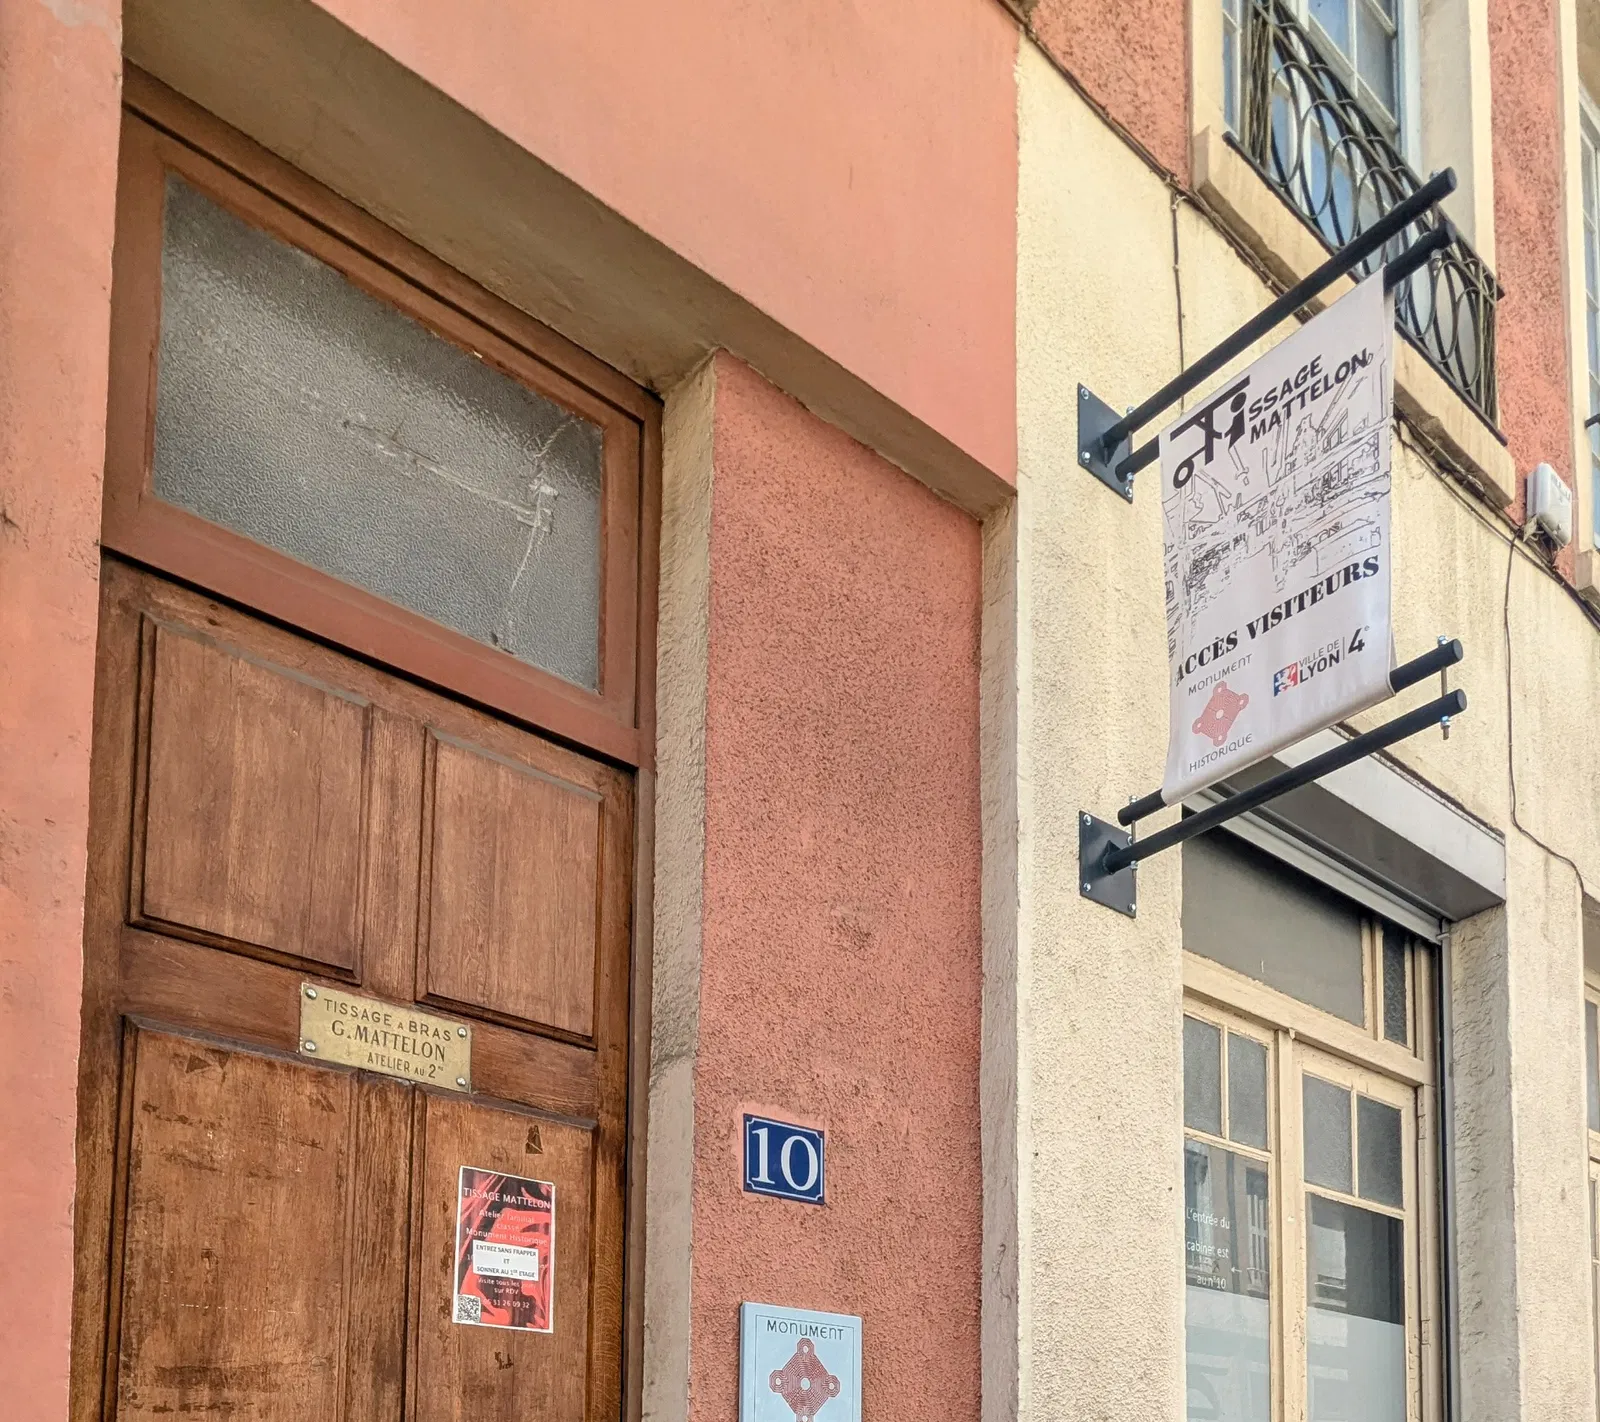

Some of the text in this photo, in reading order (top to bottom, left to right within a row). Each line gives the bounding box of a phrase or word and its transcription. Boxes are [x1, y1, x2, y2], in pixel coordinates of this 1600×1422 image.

[1250, 348, 1368, 444] MATTELON
[1175, 555, 1380, 687] ACCÈS VISITEURS
[1299, 638, 1340, 668] VILLE DE
[1188, 652, 1253, 697] MONUMENT
[1299, 650, 1340, 684] LYON
[1188, 732, 1253, 773] HISTORIQUE
[323, 998, 393, 1028] TISSAGE
[408, 1020, 452, 1042] BRAS
[367, 1051, 411, 1072] ATELIER
[414, 1066, 425, 1076] AU
[750, 1127, 819, 1192] 10
[463, 1187, 551, 1209] TISSAGE MATTELON
[479, 1209, 504, 1219] Atelier
[1219, 1216, 1231, 1230] du
[465, 1227, 548, 1246] Monument Historique
[476, 1244, 537, 1257] ENTREZ SANS FRAPPER
[1186, 1240, 1229, 1259] cabinet est
[476, 1266, 500, 1275] SONNER
[766, 1318, 844, 1341] MONUMENT
